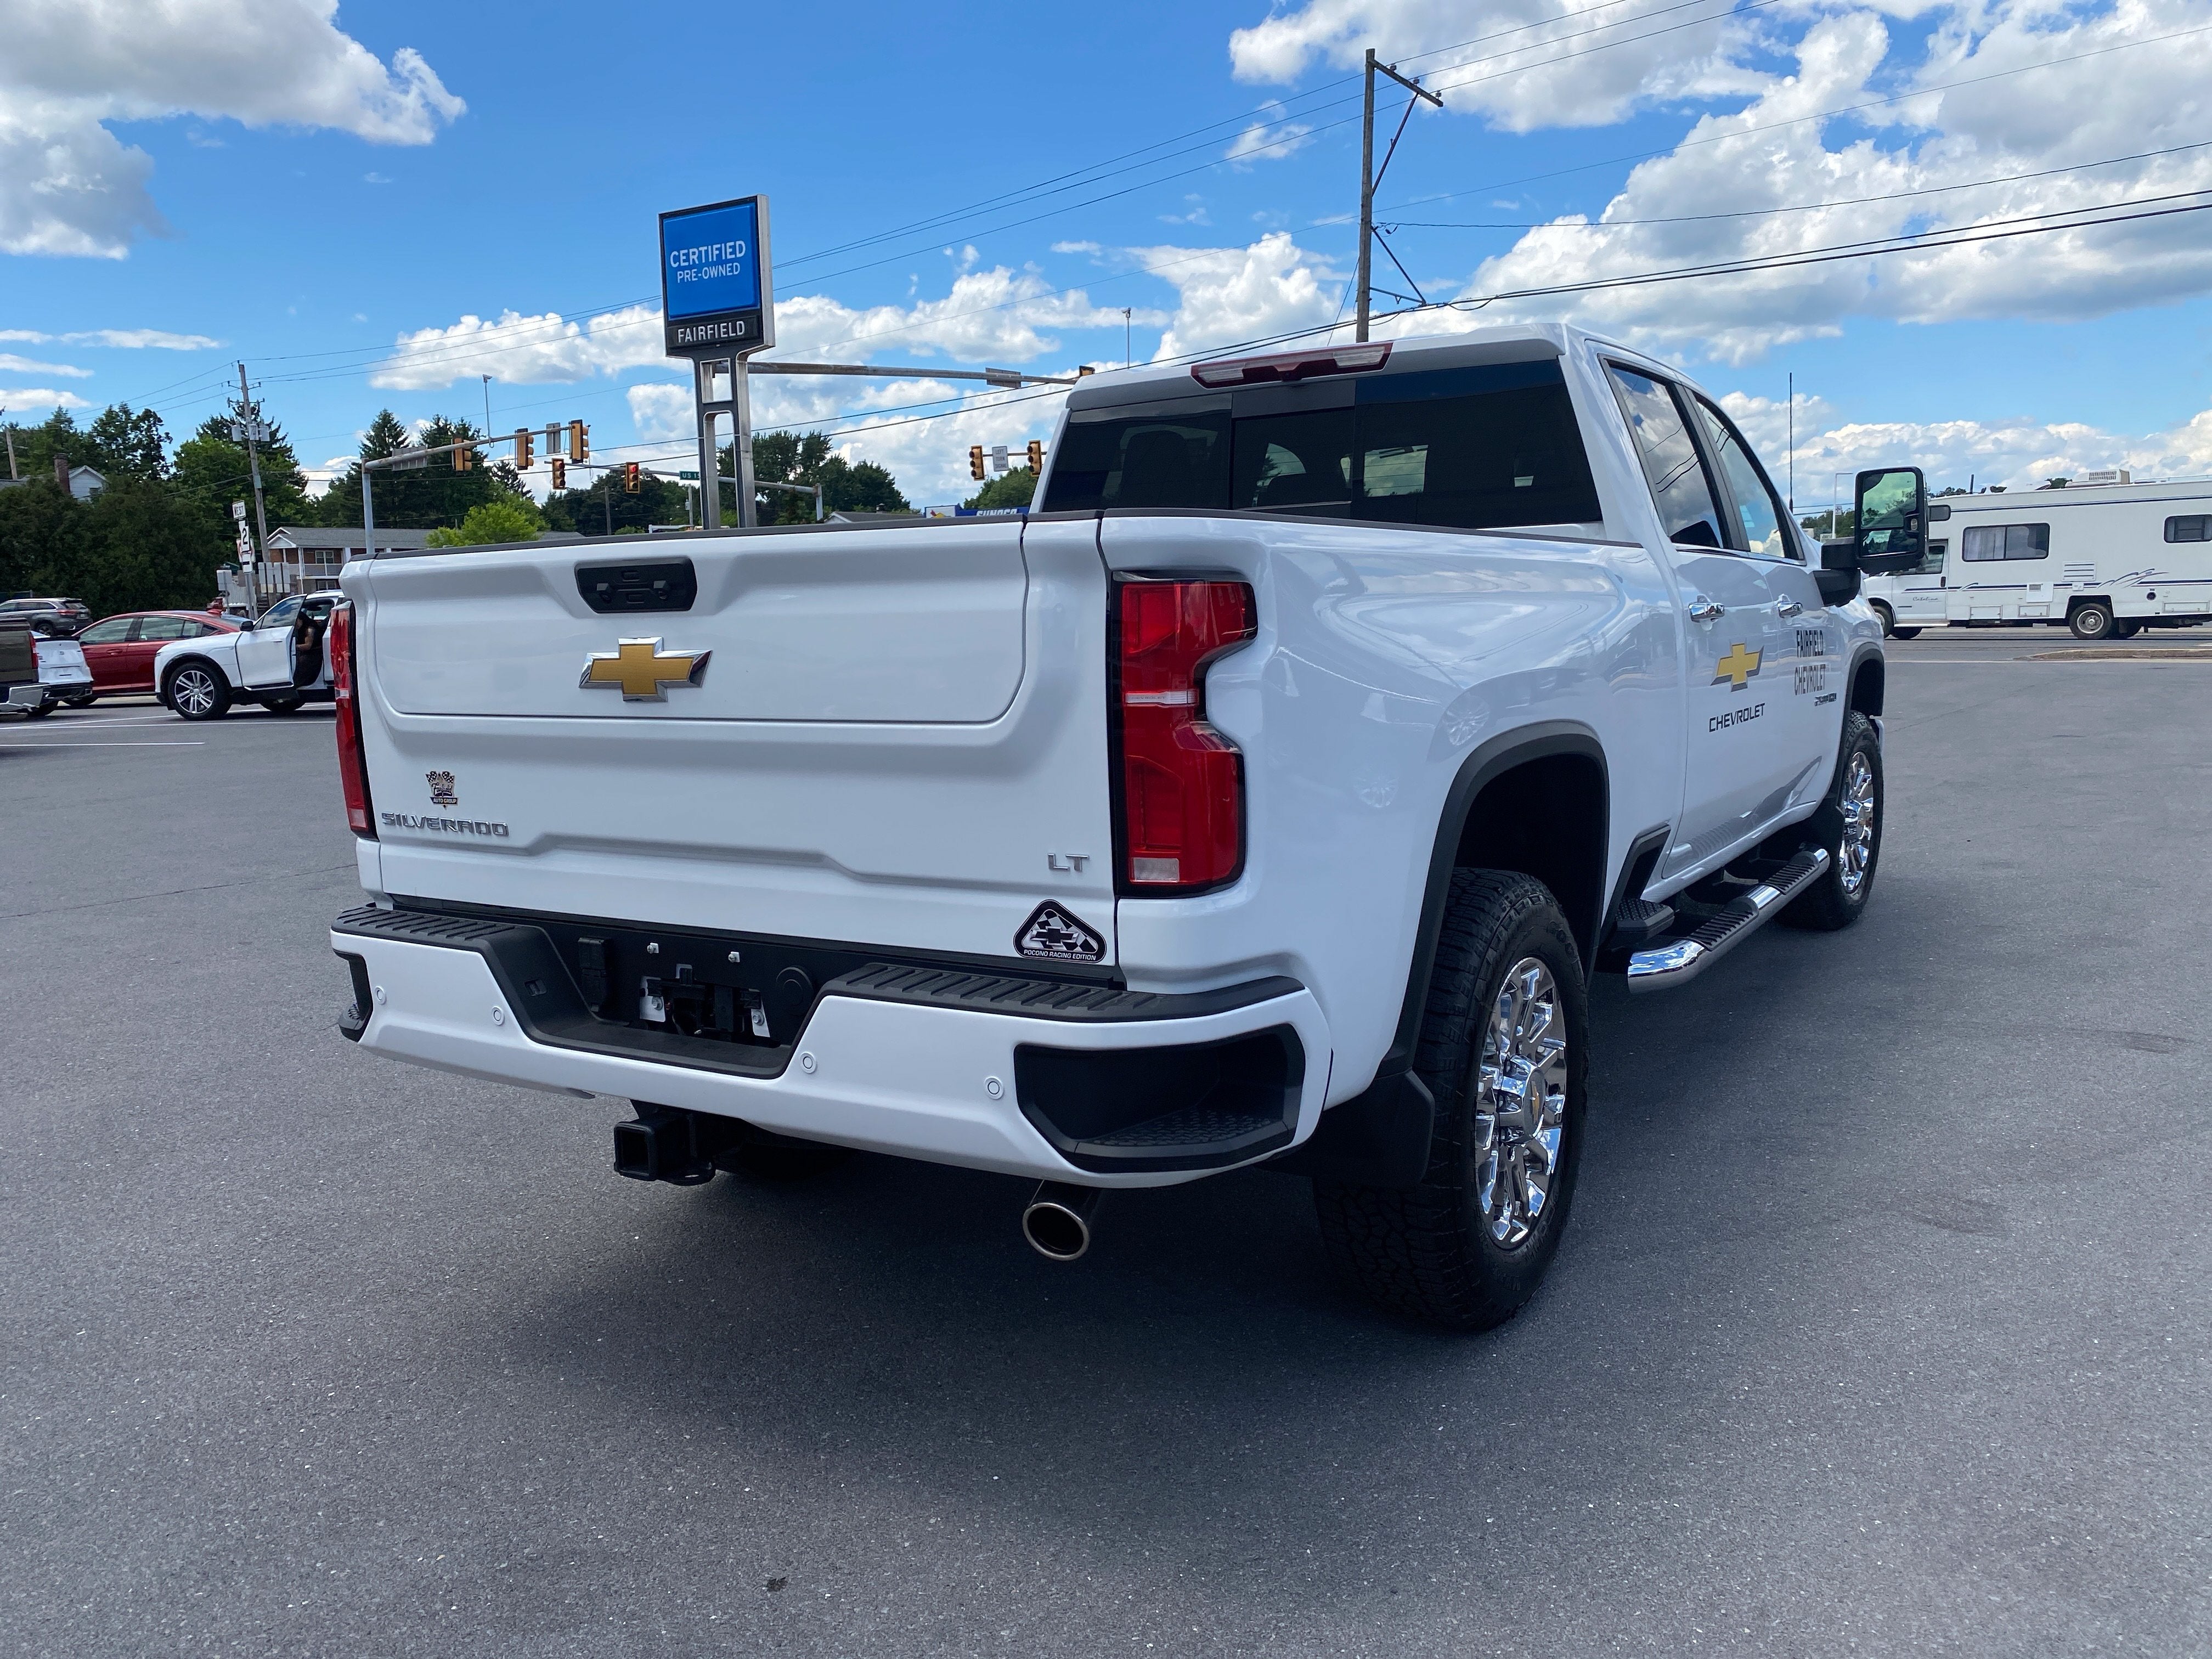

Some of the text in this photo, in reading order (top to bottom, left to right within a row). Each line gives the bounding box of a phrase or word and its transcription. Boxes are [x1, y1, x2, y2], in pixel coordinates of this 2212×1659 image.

[670, 240, 746, 268] CERTIFIED
[677, 262, 741, 284] PRE-OWNED
[678, 321, 746, 343] FAIRFIELD
[1796, 630, 1823, 658] FAIRFIELD
[1795, 664, 1825, 696] CHEVROLET
[1709, 703, 1765, 732] CHEVROLET
[381, 812, 510, 837] SILVERADO
[1047, 853, 1089, 871] LT
